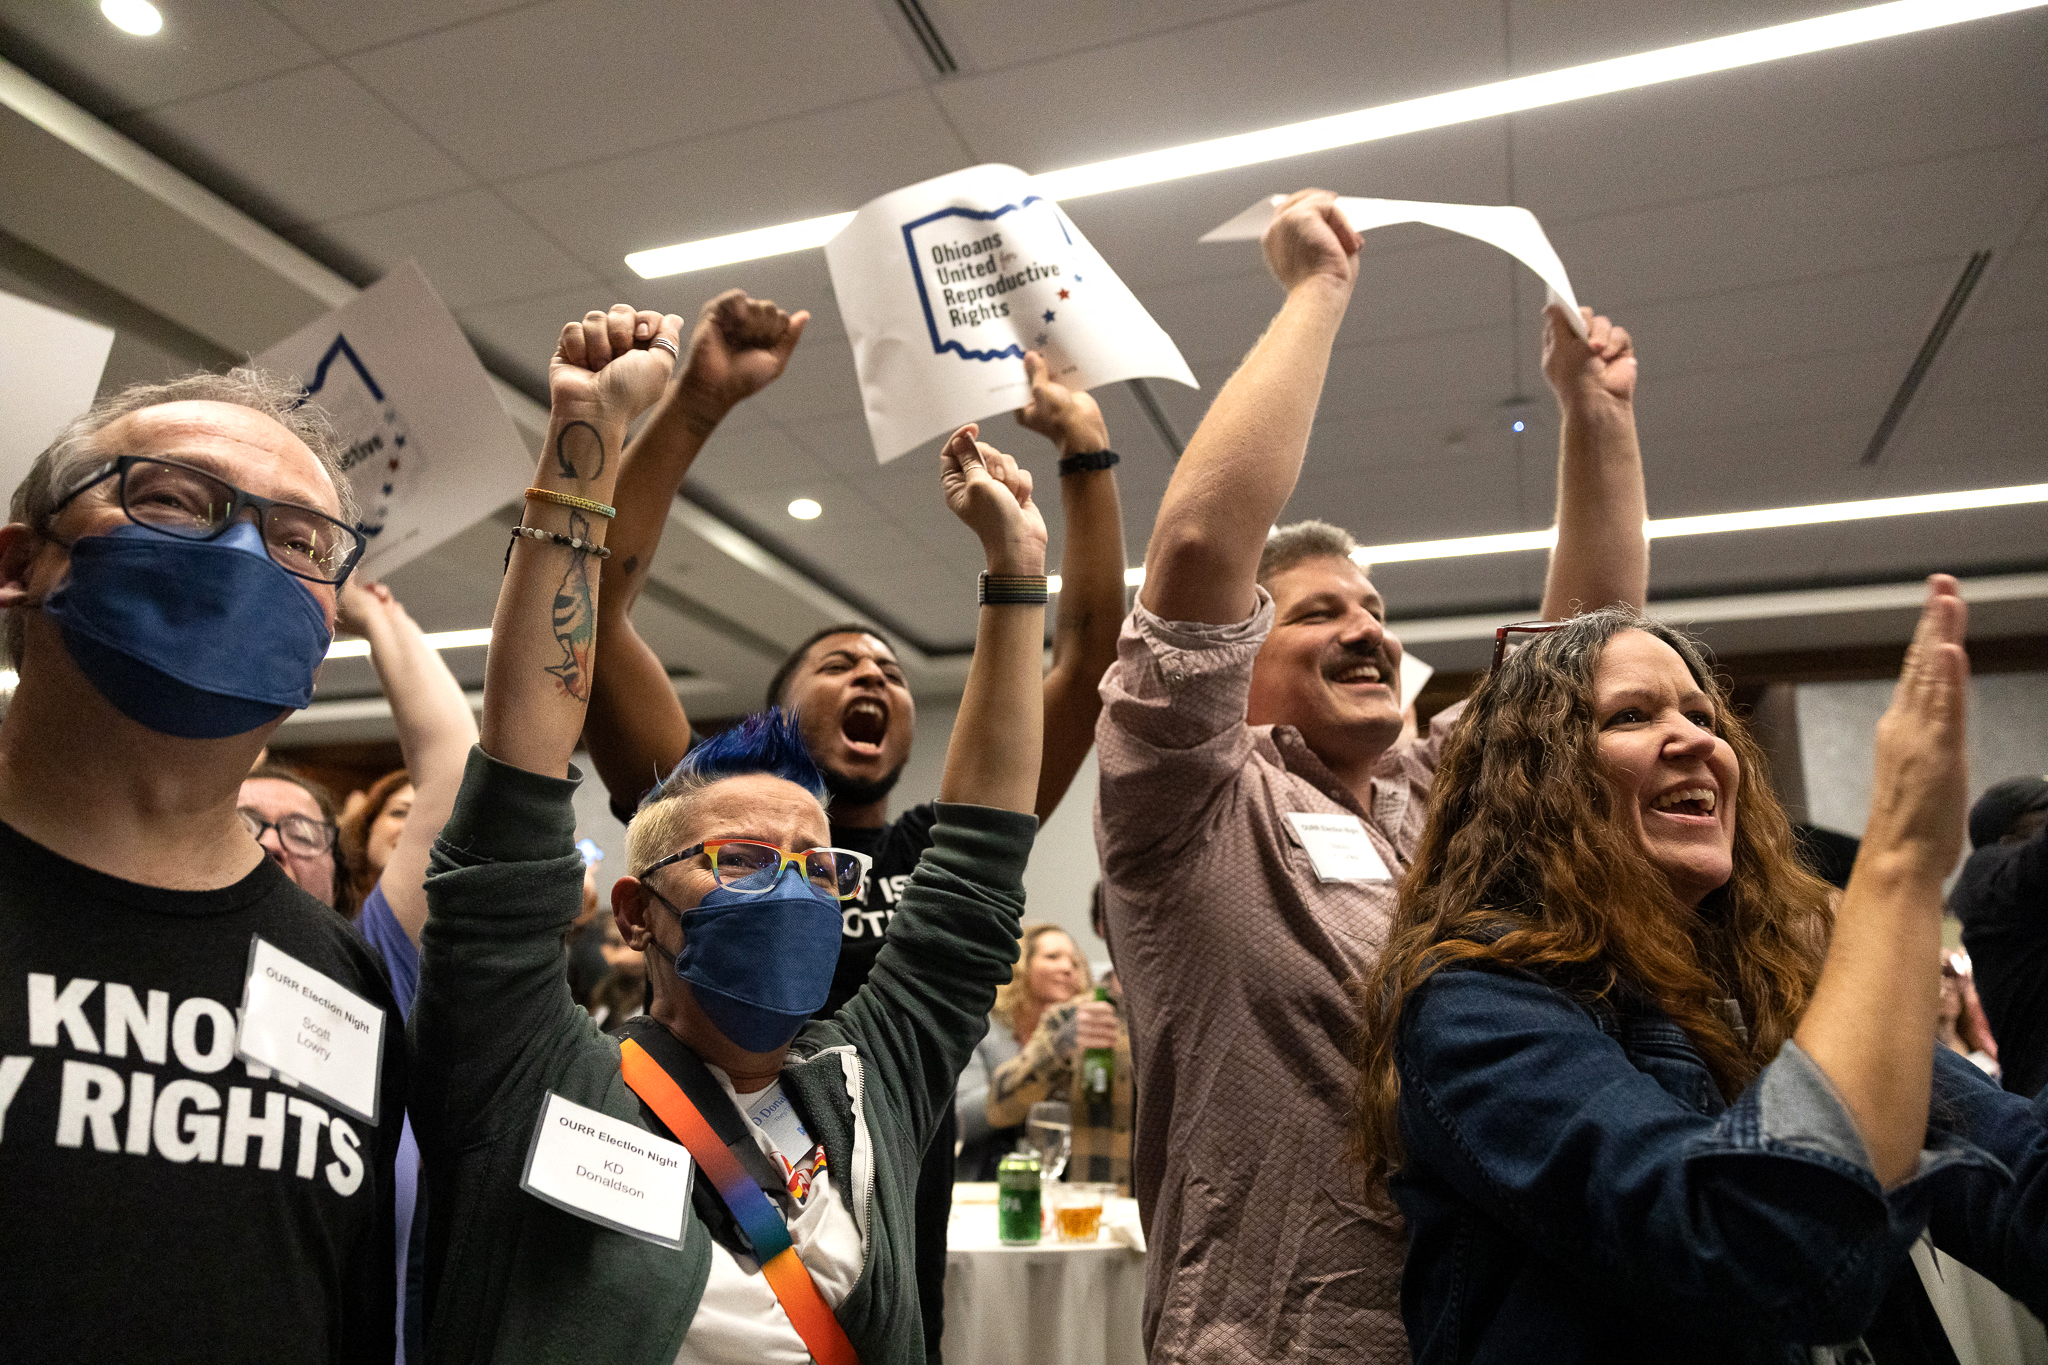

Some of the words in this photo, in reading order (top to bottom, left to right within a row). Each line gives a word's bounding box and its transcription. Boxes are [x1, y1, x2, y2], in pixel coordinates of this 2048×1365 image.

[932, 233, 1002, 264] Ohioans
[936, 254, 997, 285] United
[943, 262, 1060, 306] Reproductive
[949, 302, 1010, 327] Rights
[266, 967, 299, 992] OURR
[302, 987, 342, 1017] Election
[345, 1011, 370, 1034] Night
[302, 1016, 331, 1041] Scott
[297, 1032, 331, 1061] Lowry
[56, 1059, 365, 1197] RIGHTS
[559, 1117, 595, 1137] OURR
[598, 1132, 644, 1156] Election
[647, 1151, 678, 1169] Night
[576, 1165, 645, 1199] Donaldson
[603, 1160, 624, 1175] KD
